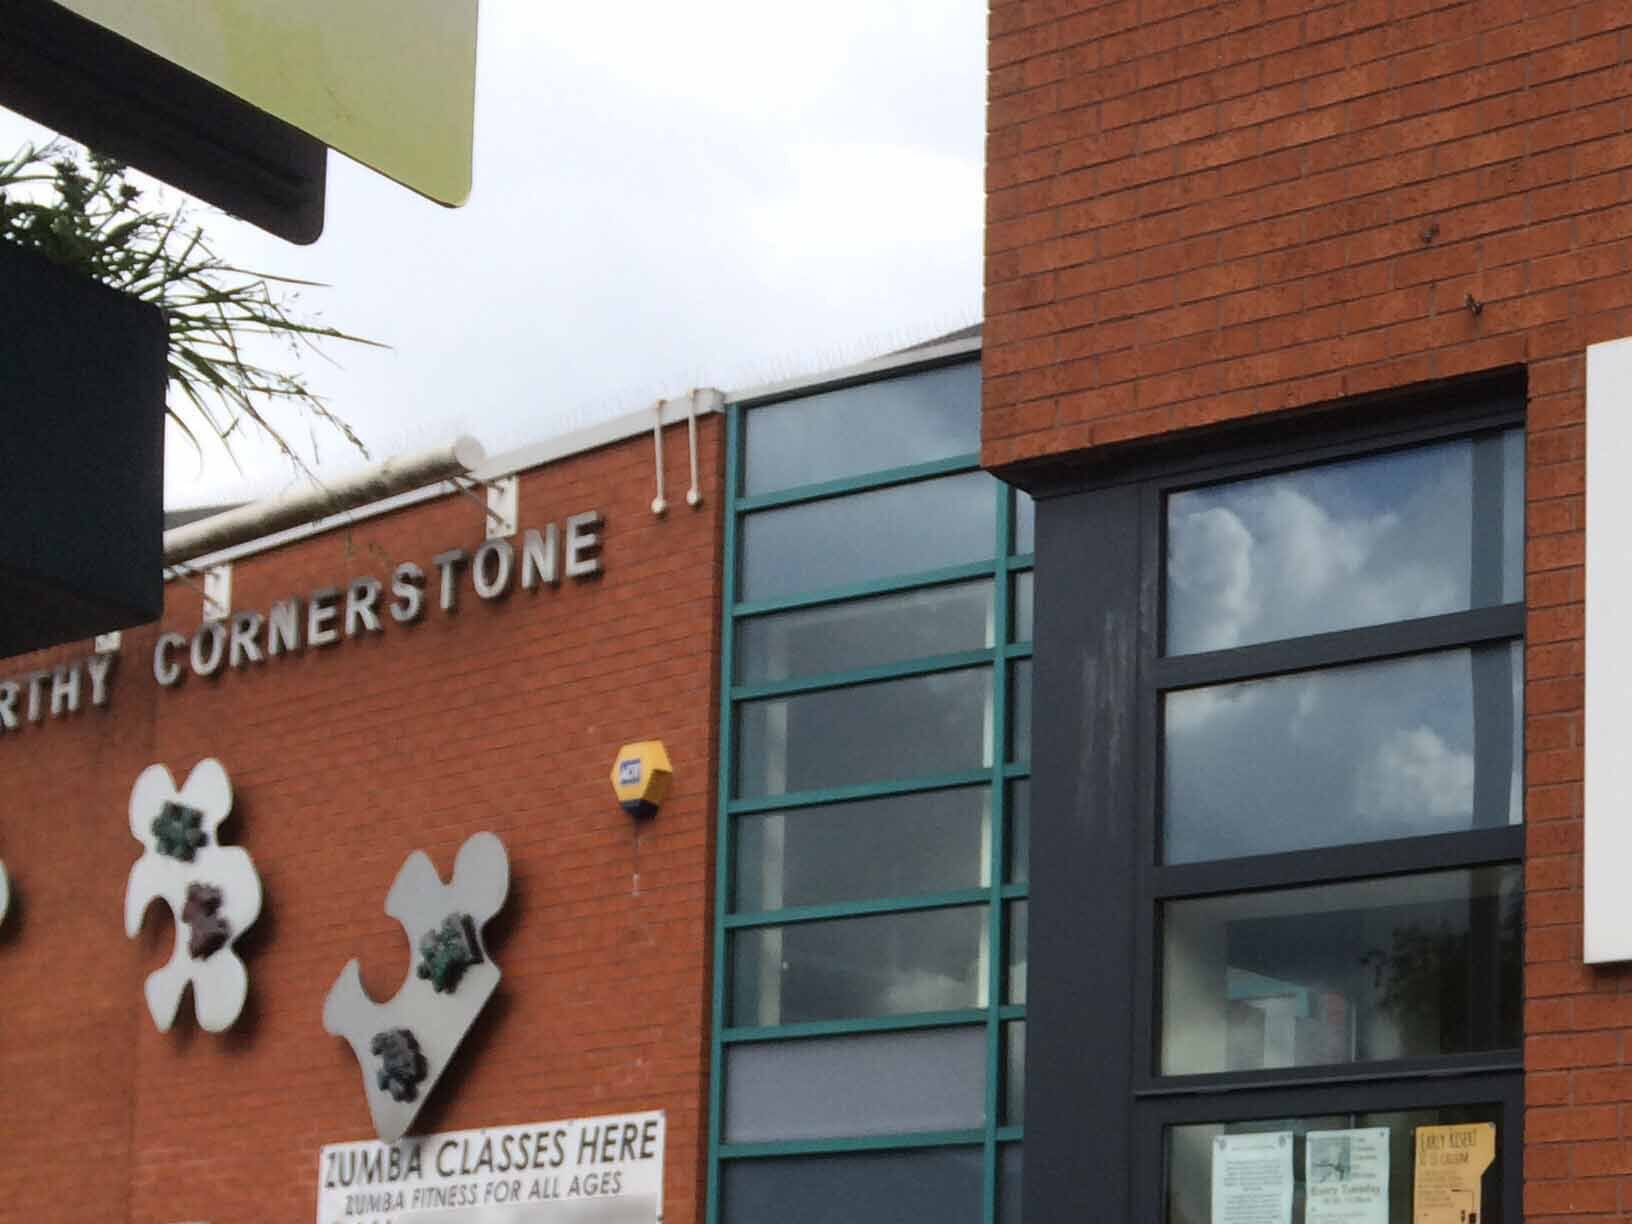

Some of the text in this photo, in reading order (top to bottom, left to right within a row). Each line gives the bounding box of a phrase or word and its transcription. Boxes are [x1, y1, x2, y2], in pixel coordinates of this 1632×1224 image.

[152, 511, 602, 686] CORNERSTONE
[325, 1121, 657, 1188] ZUMBA CLASSES HERE
[346, 1172, 622, 1216] ZUMBA FITNESS FOR ALL AGES
